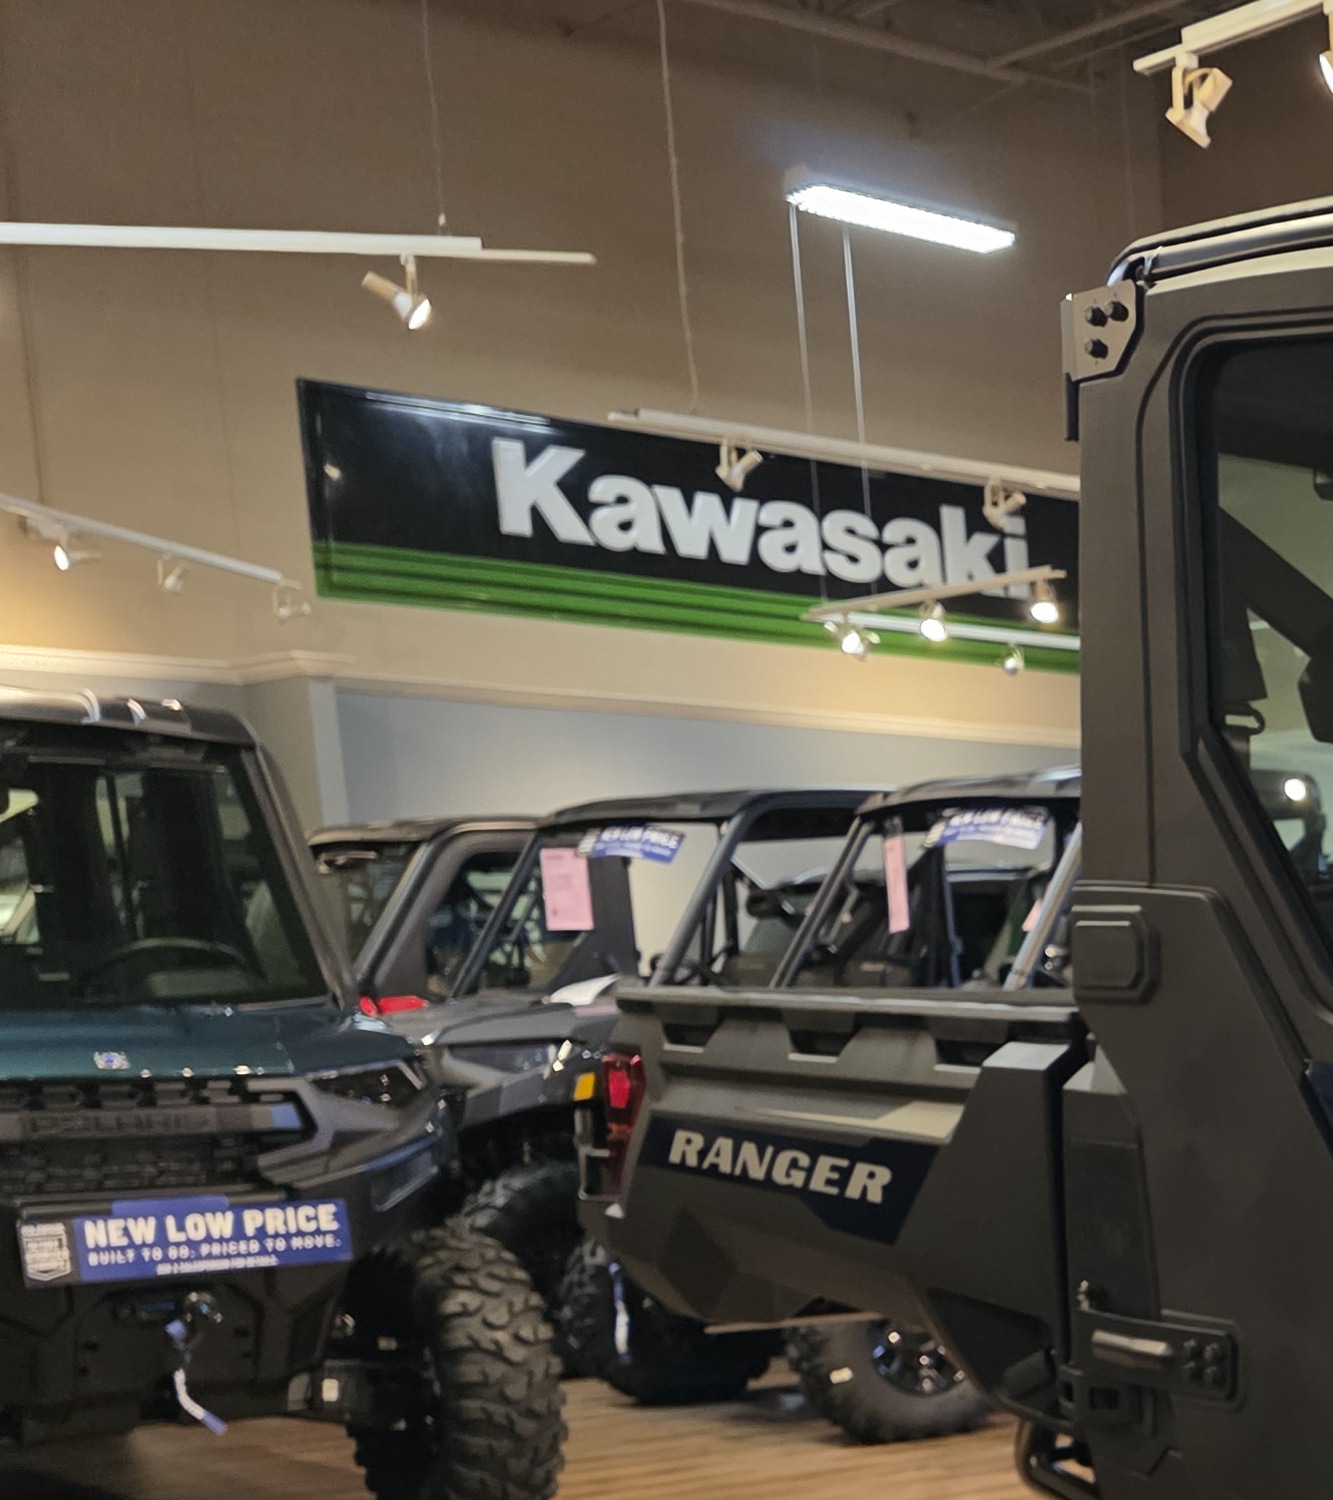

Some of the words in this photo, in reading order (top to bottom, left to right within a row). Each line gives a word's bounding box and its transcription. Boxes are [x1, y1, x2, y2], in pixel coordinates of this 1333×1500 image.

[491, 437, 1032, 600] Kawasaki
[667, 1128, 893, 1205] RANGER
[83, 1215, 157, 1249] NEW
[165, 1210, 235, 1244] LOW
[242, 1203, 340, 1238] PRICE
